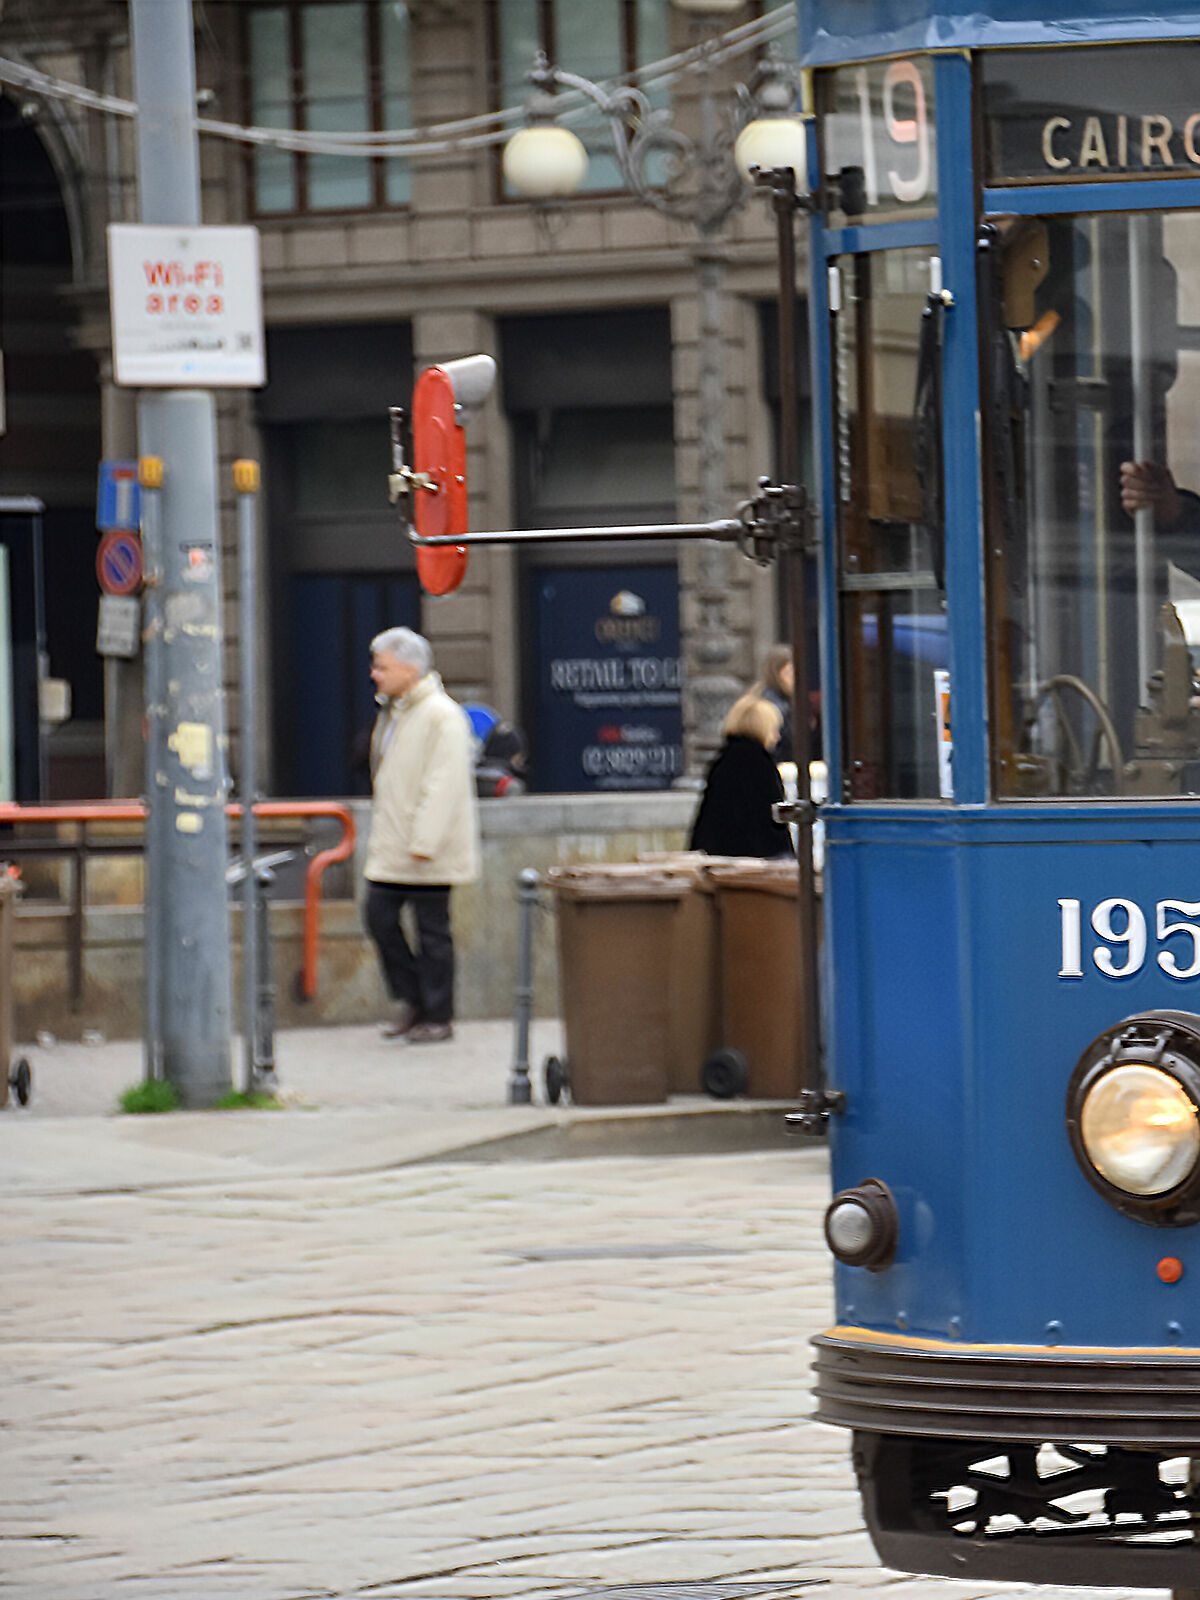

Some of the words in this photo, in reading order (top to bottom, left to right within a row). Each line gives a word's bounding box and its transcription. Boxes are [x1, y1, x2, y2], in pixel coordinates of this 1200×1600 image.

[855, 61, 929, 205] 19
[143, 260, 224, 287] Wi-Fi
[146, 293, 225, 315] area
